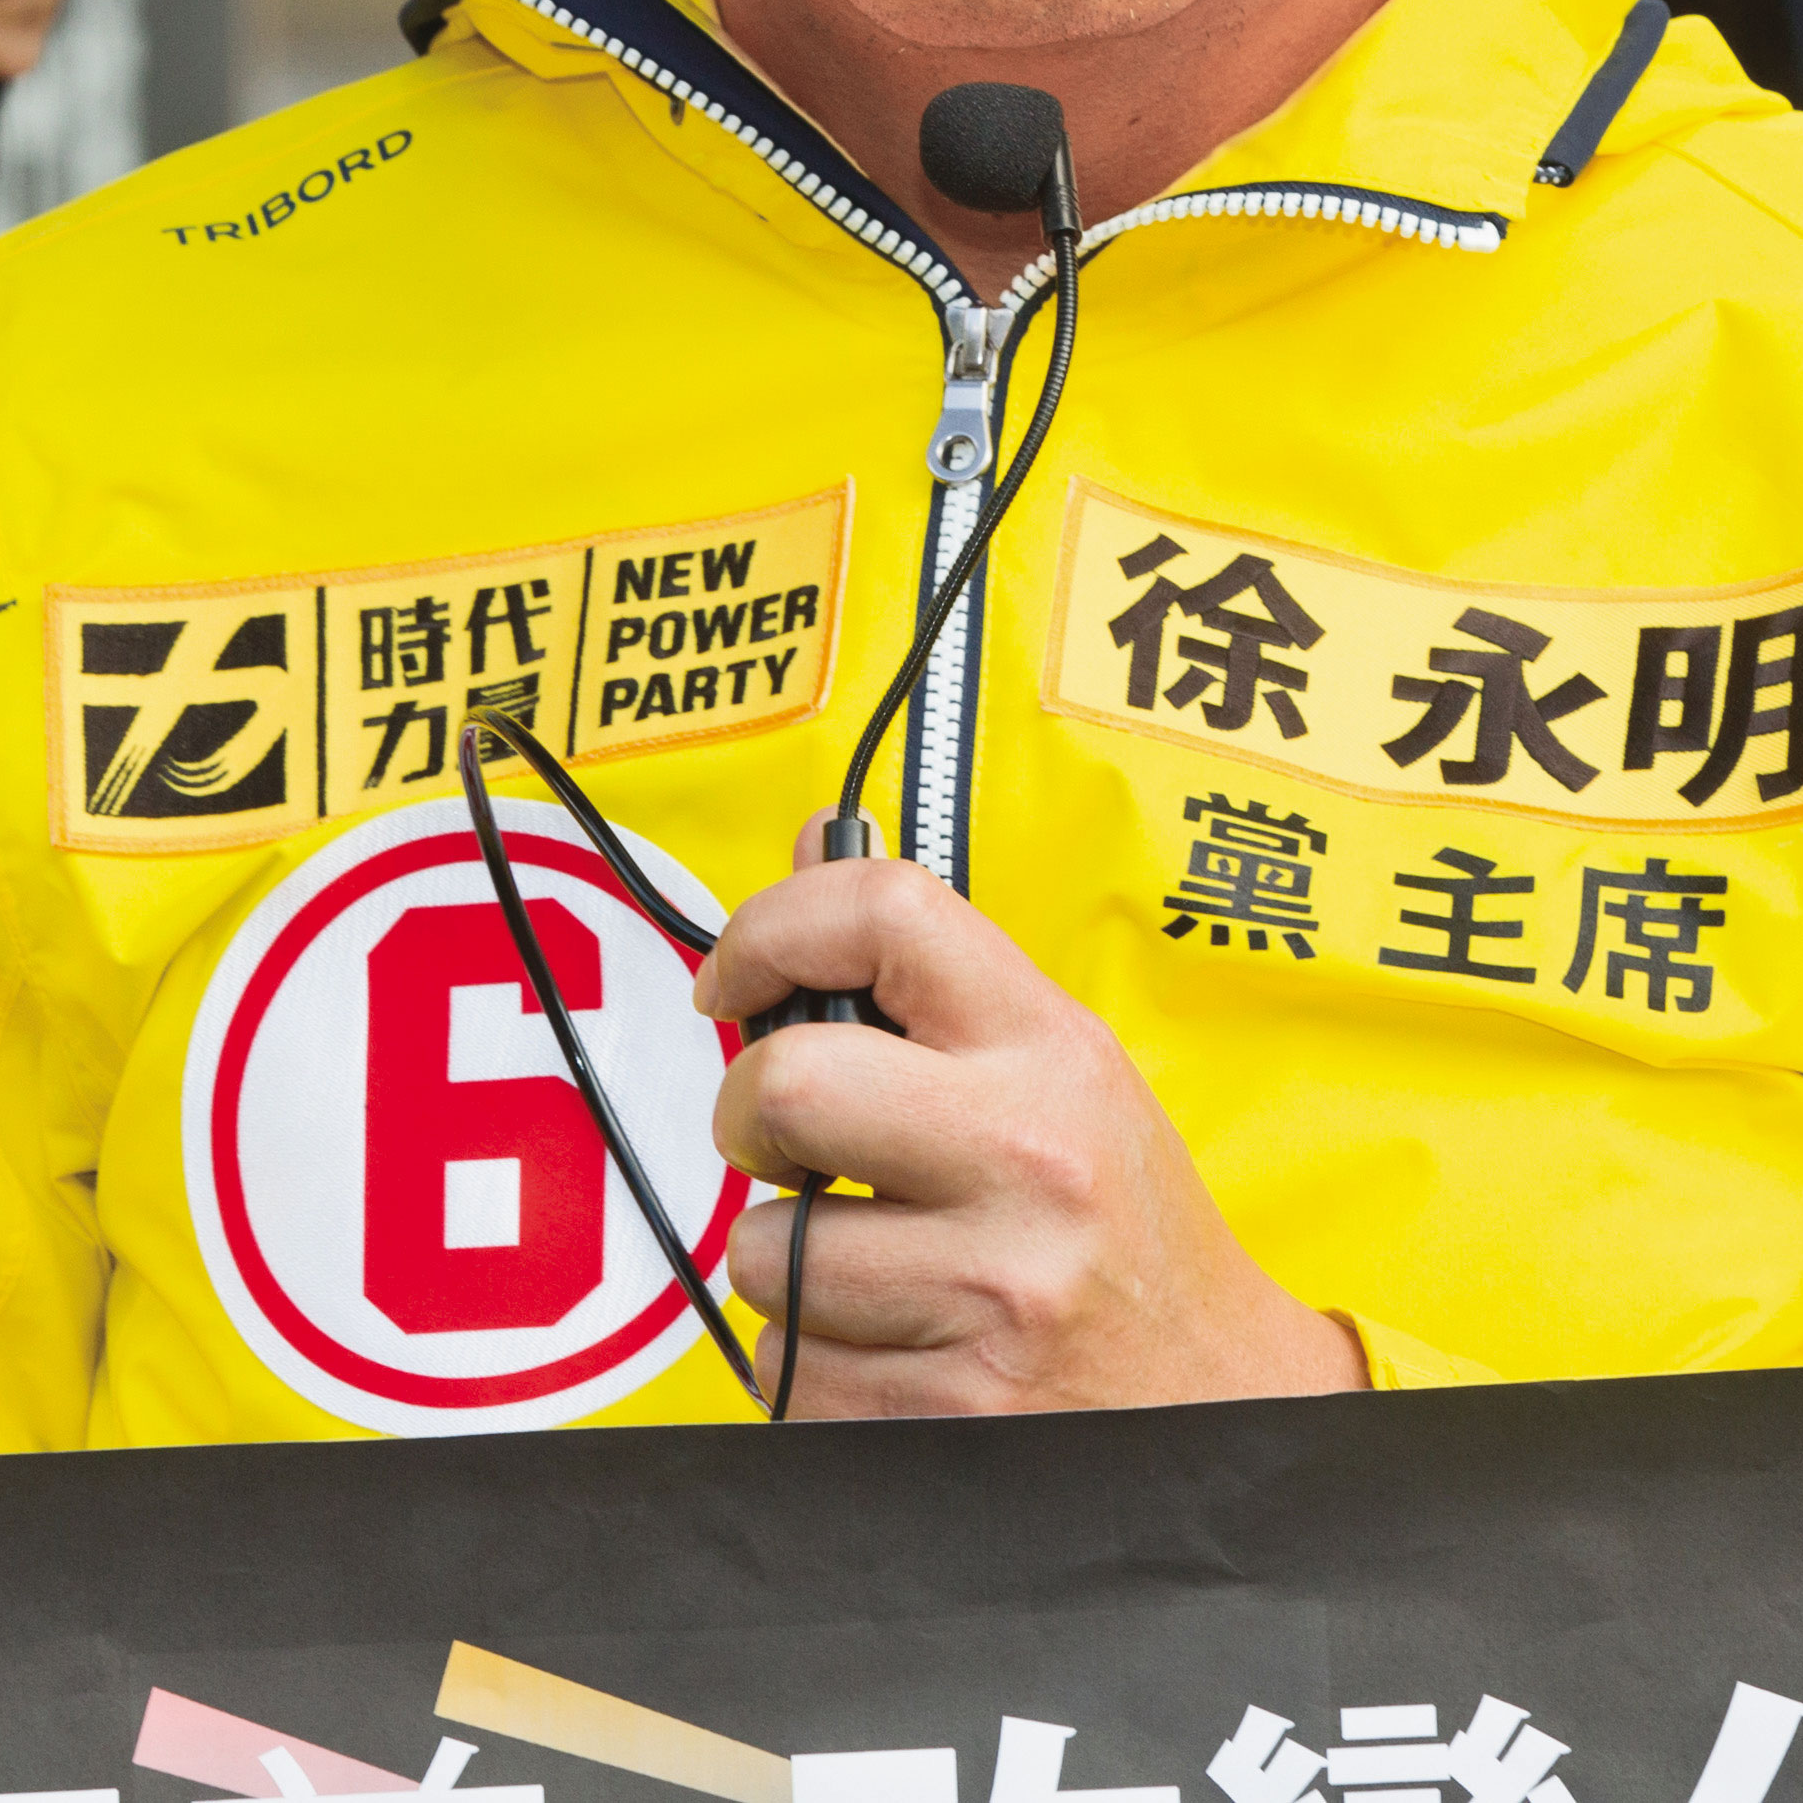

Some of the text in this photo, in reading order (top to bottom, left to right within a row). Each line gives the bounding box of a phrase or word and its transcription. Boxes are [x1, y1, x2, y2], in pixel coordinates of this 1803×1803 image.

[161, 129, 413, 245] TRIBORD
[613, 539, 757, 605] NEW
[359, 578, 552, 691] 時代
[606, 584, 820, 664] POWER
[599, 647, 798, 728] PARTY
[363, 897, 606, 1336] 6
